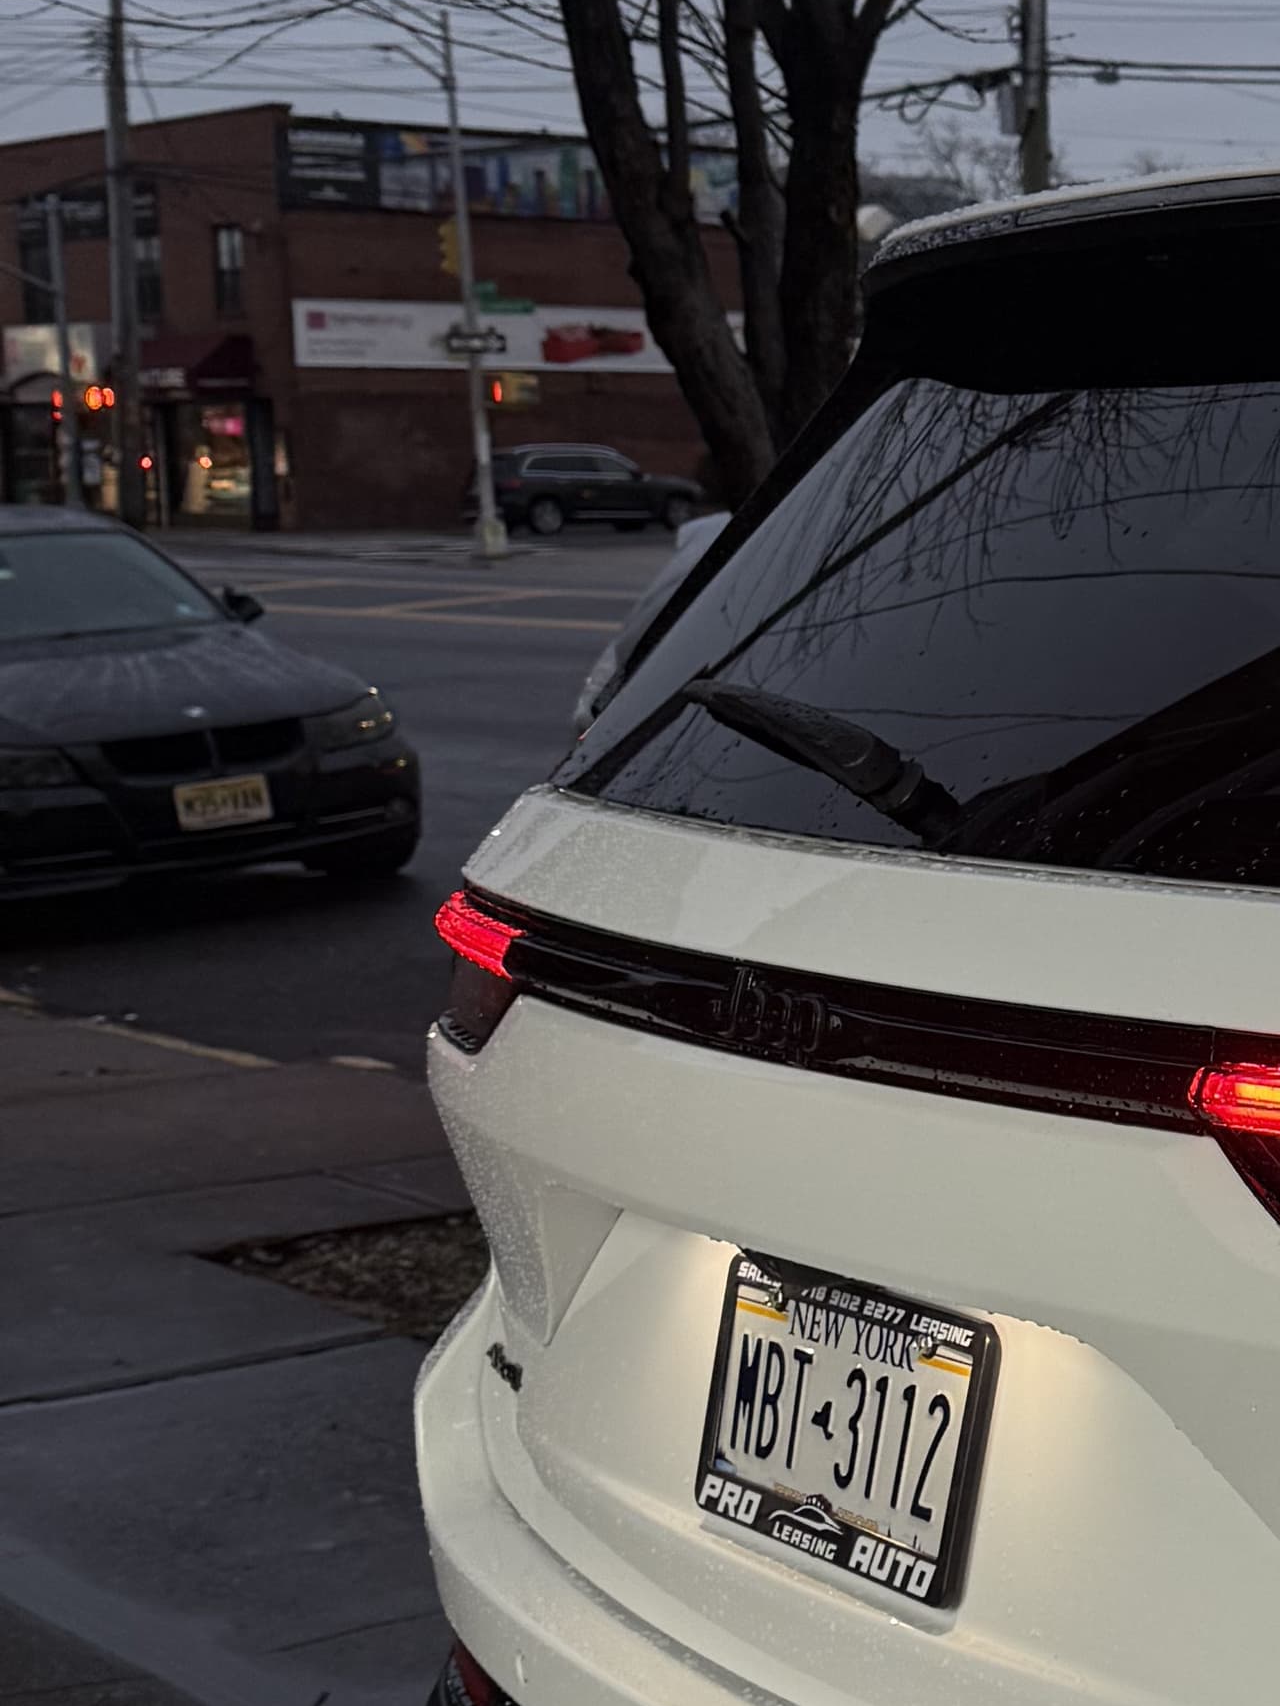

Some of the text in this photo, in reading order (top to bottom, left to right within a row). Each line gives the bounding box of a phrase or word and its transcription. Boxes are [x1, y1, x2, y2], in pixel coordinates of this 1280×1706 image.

[788, 1300, 917, 1372] NEW YORK
[829, 1289, 861, 1311] 902
[863, 1300, 906, 1324] 2277
[909, 1313, 976, 1347] LEASING
[730, 1333, 952, 1523] MBT 3112
[699, 1474, 937, 1598] PRO AUTO
[772, 1521, 838, 1560] LEASING
